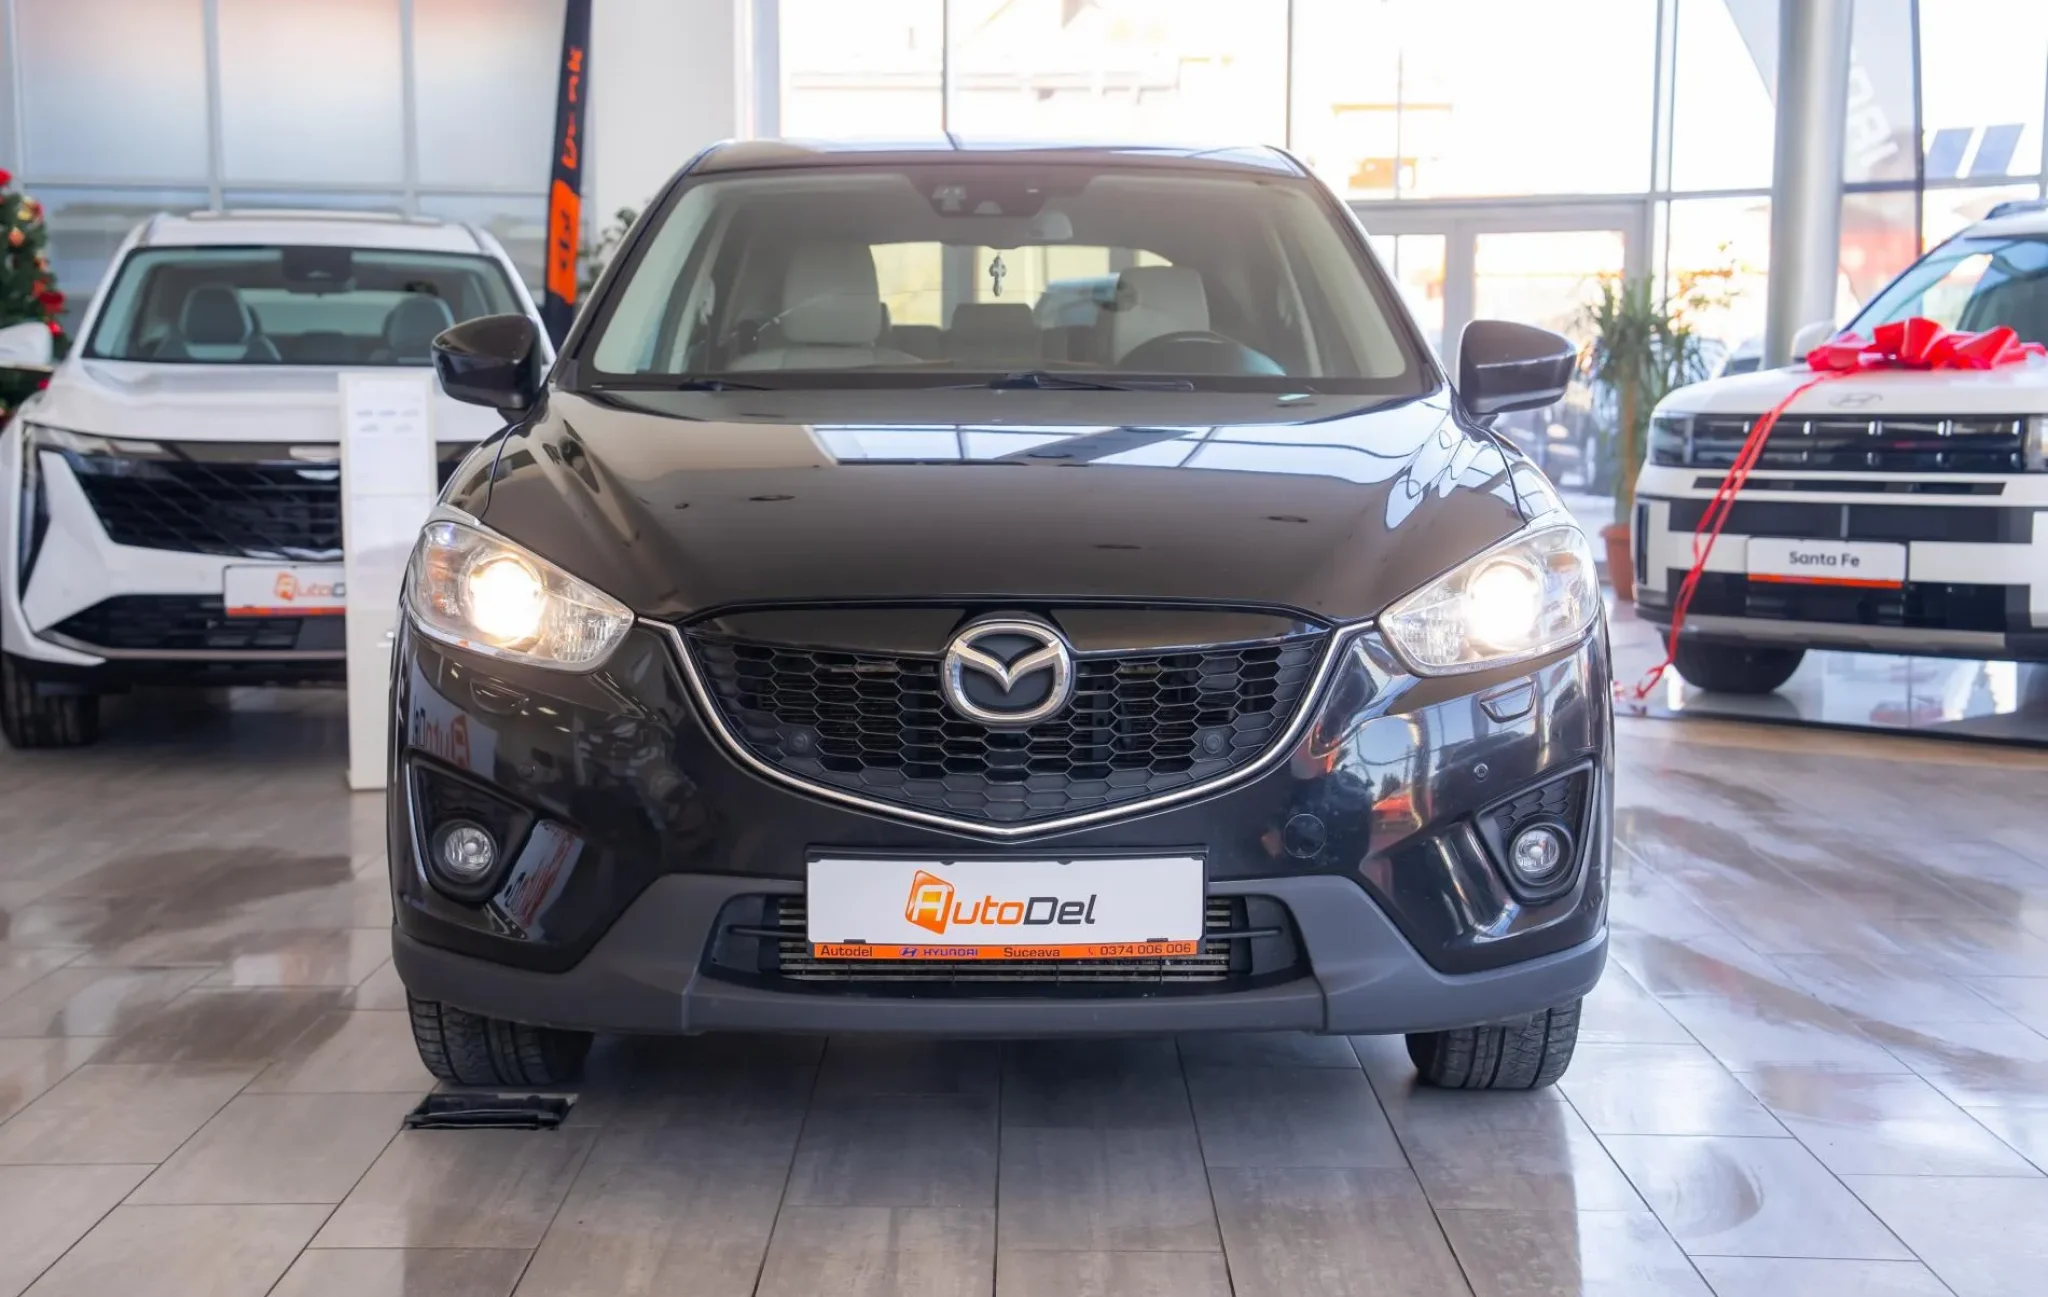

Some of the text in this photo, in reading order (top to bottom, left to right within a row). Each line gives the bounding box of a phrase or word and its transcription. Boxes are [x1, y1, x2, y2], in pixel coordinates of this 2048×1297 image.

[1789, 551, 1860, 567] Santa Fe
[907, 877, 1097, 929] AutoDel
[820, 943, 1191, 957] Autodel HYUNDAI Suceava 0374 006 006
